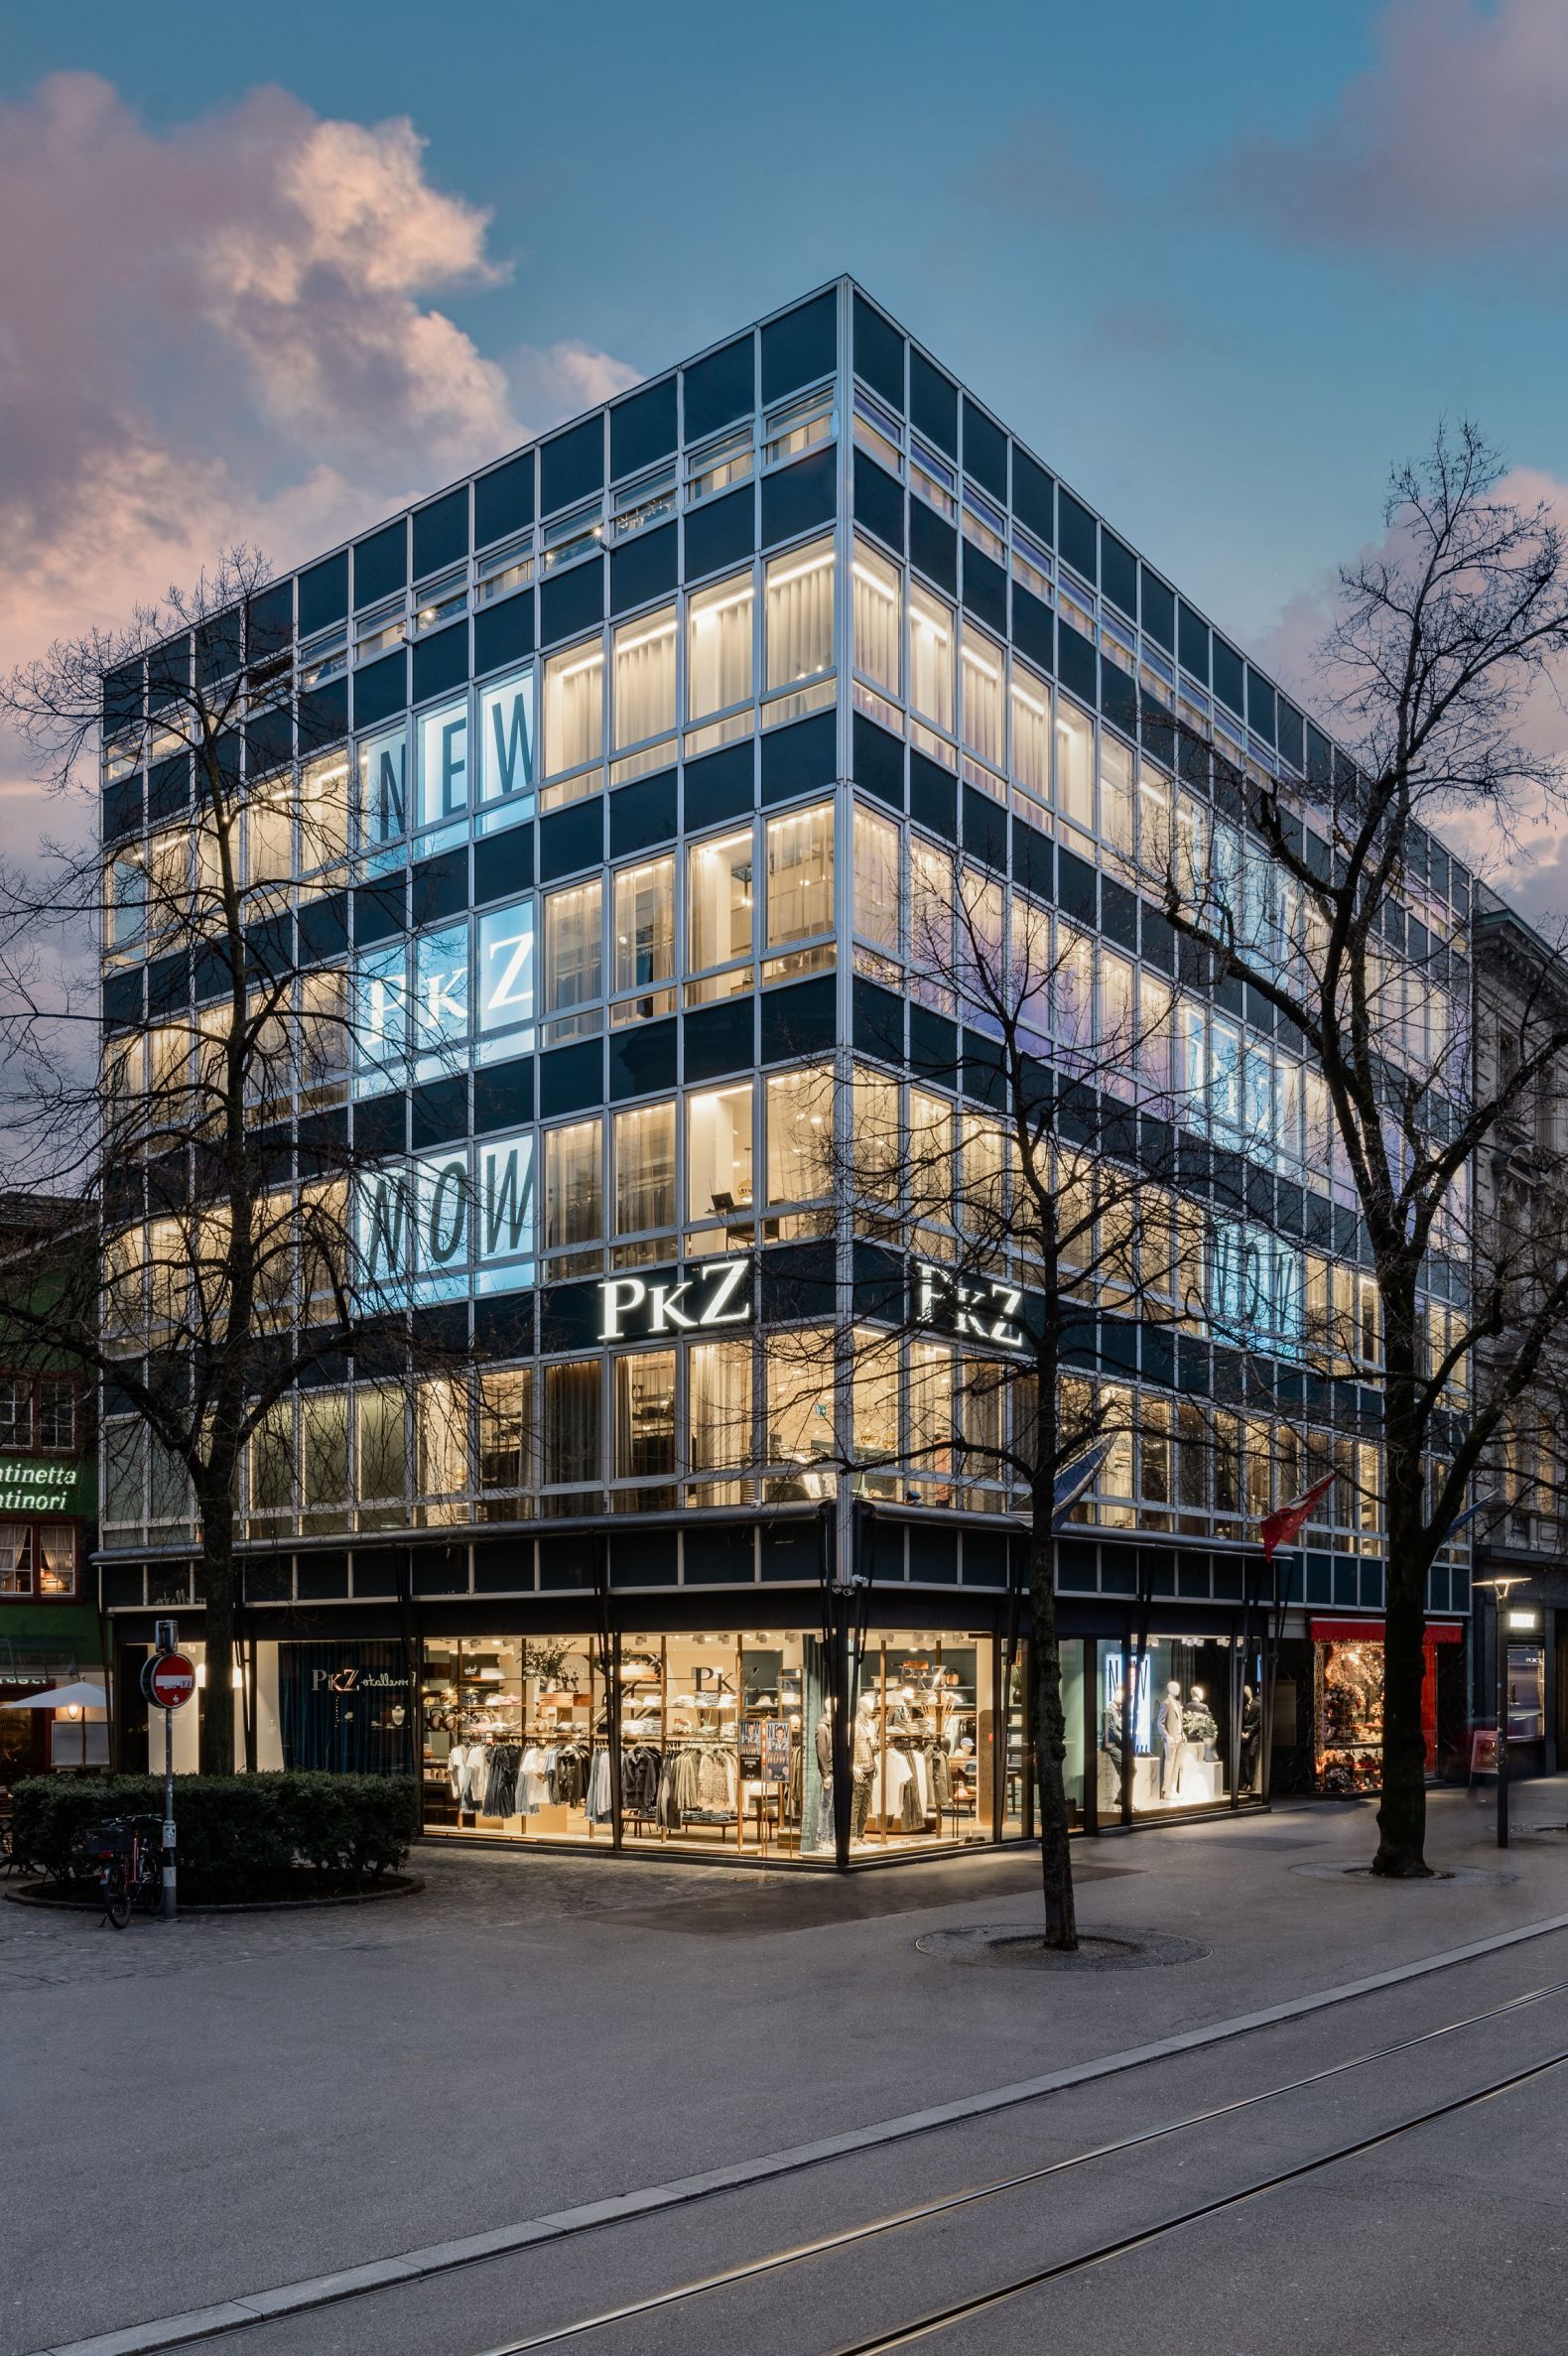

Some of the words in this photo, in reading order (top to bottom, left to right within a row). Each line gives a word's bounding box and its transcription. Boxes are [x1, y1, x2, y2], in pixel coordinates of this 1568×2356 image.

[380, 693, 534, 843] NEW
[363, 932, 534, 1047] PKZ
[368, 1144, 534, 1276] NOW
[597, 1259, 749, 1340] PKZ
[916, 1261, 1022, 1347] PKZ
[0, 1463, 76, 1485] tinetta
[0, 1489, 67, 1509] tinori
[311, 1668, 359, 1691] PKZ
